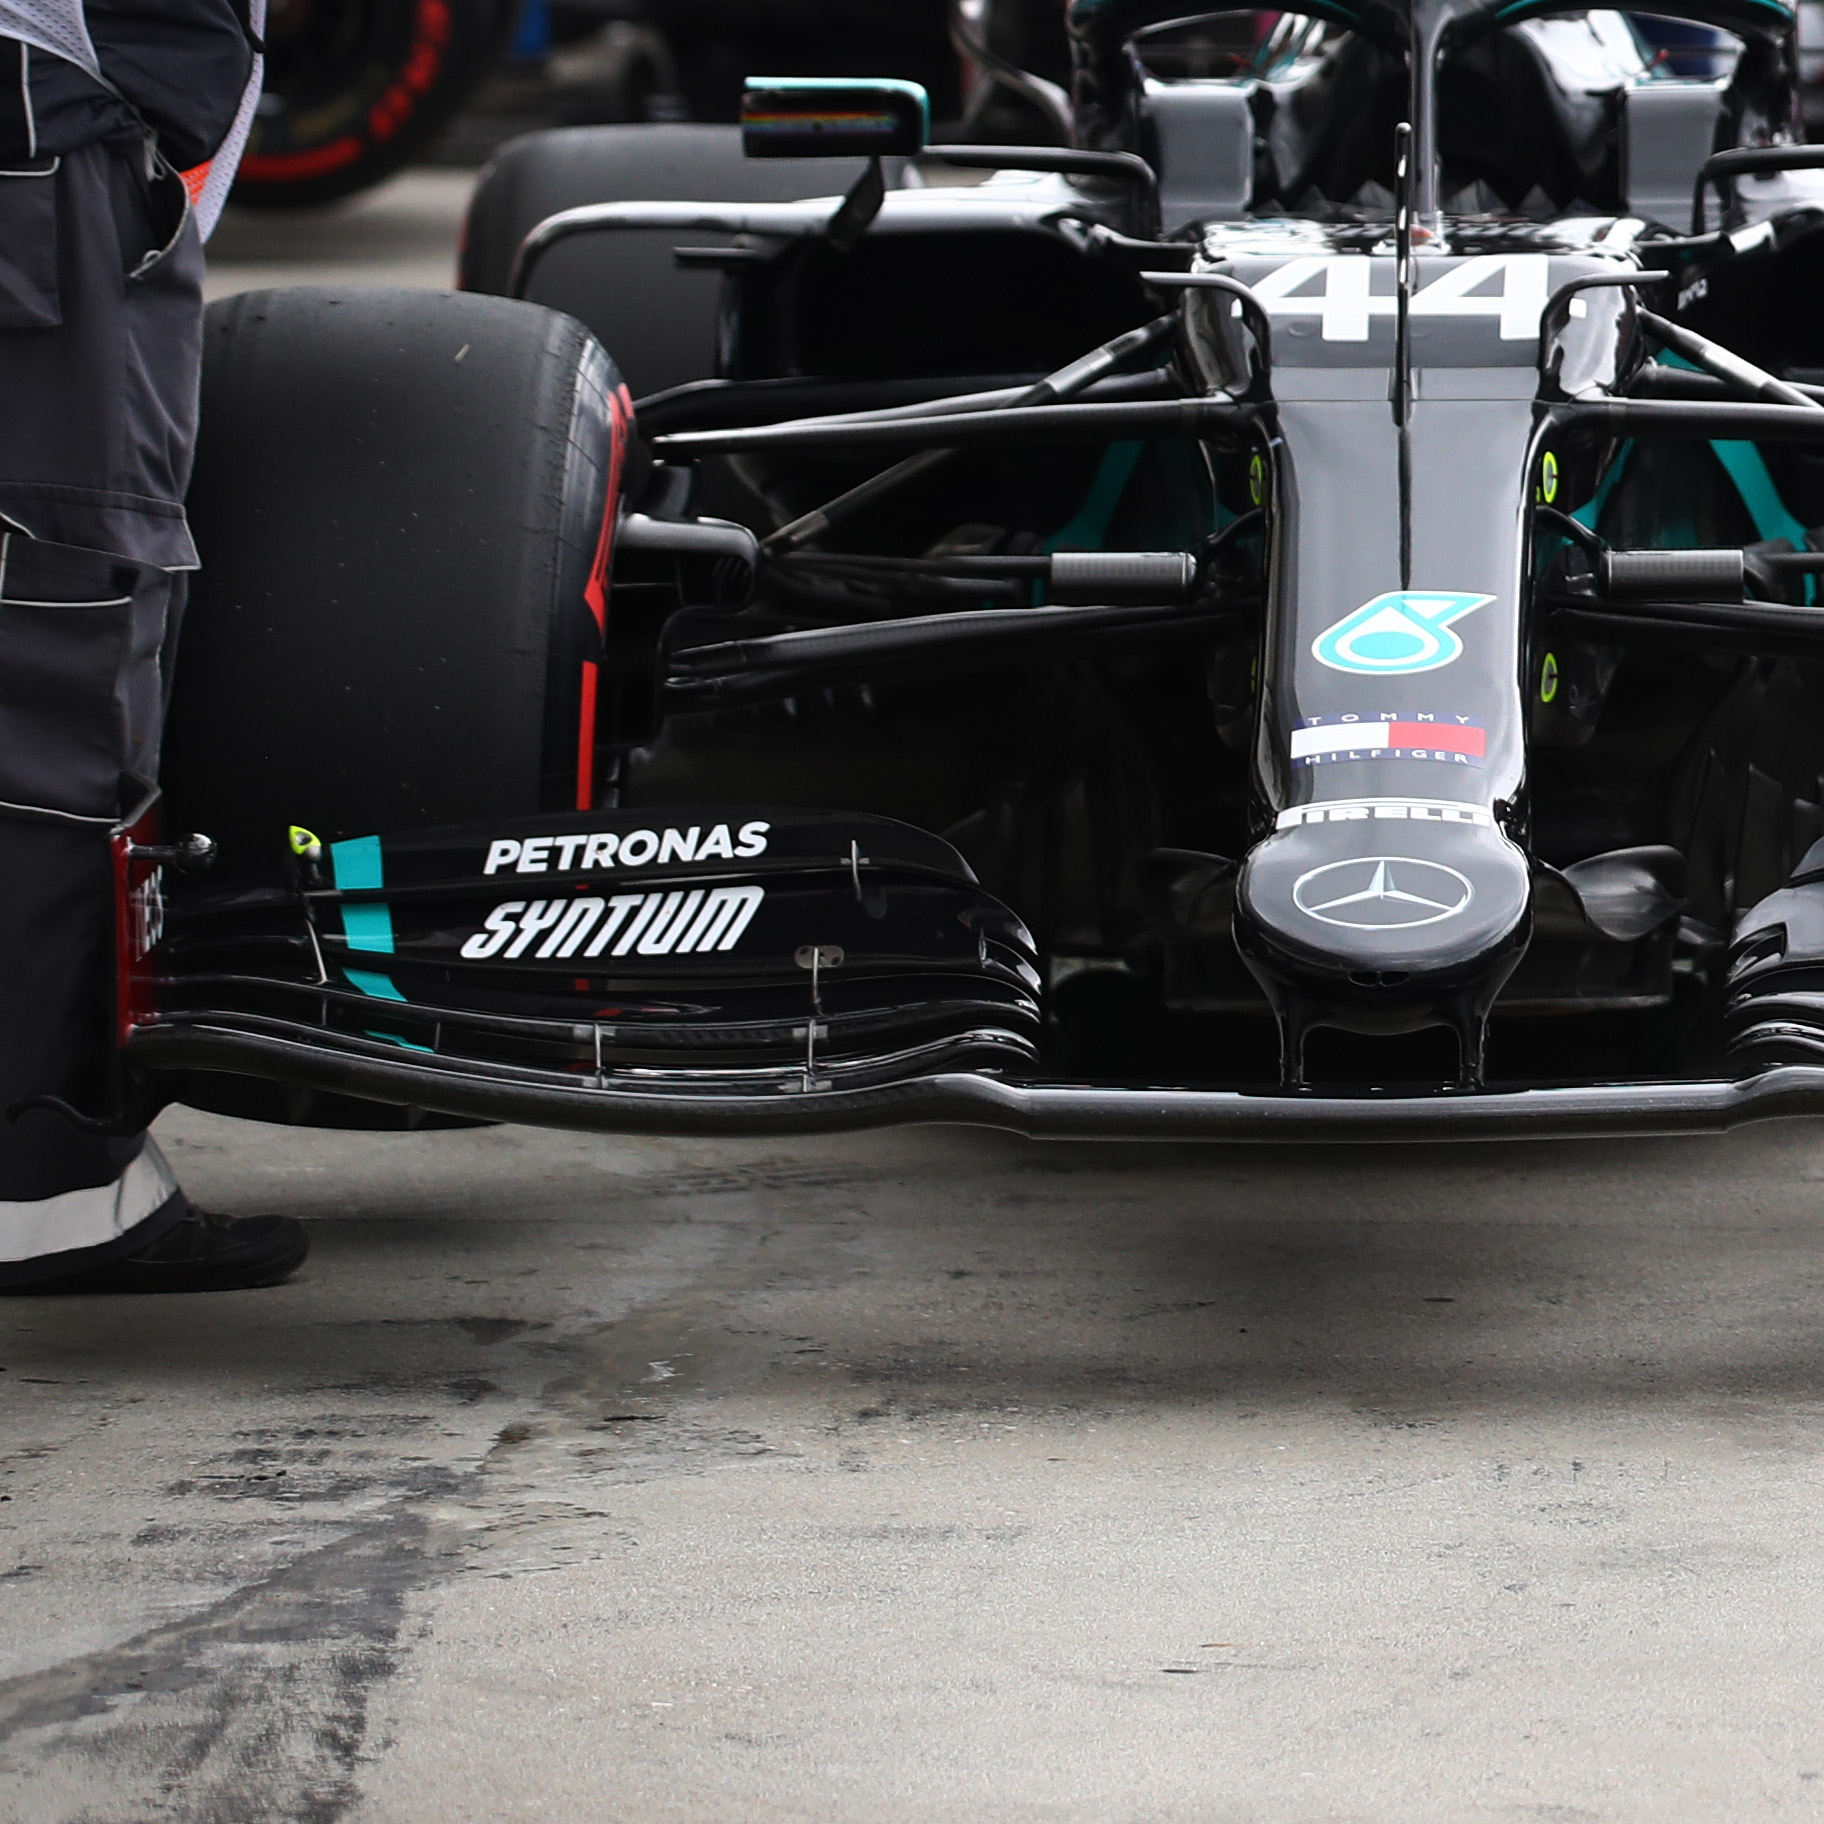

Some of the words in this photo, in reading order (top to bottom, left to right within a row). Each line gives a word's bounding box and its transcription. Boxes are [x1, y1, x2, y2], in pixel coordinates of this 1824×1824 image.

[1250, 254, 1550, 342] 44
[1307, 712, 1470, 726] TOMMY
[1305, 749, 1470, 765] HILFIGER
[1276, 797, 1492, 830] PIRELLI
[482, 820, 771, 875] PETRONAS
[459, 885, 766, 960] SYNTIUM
